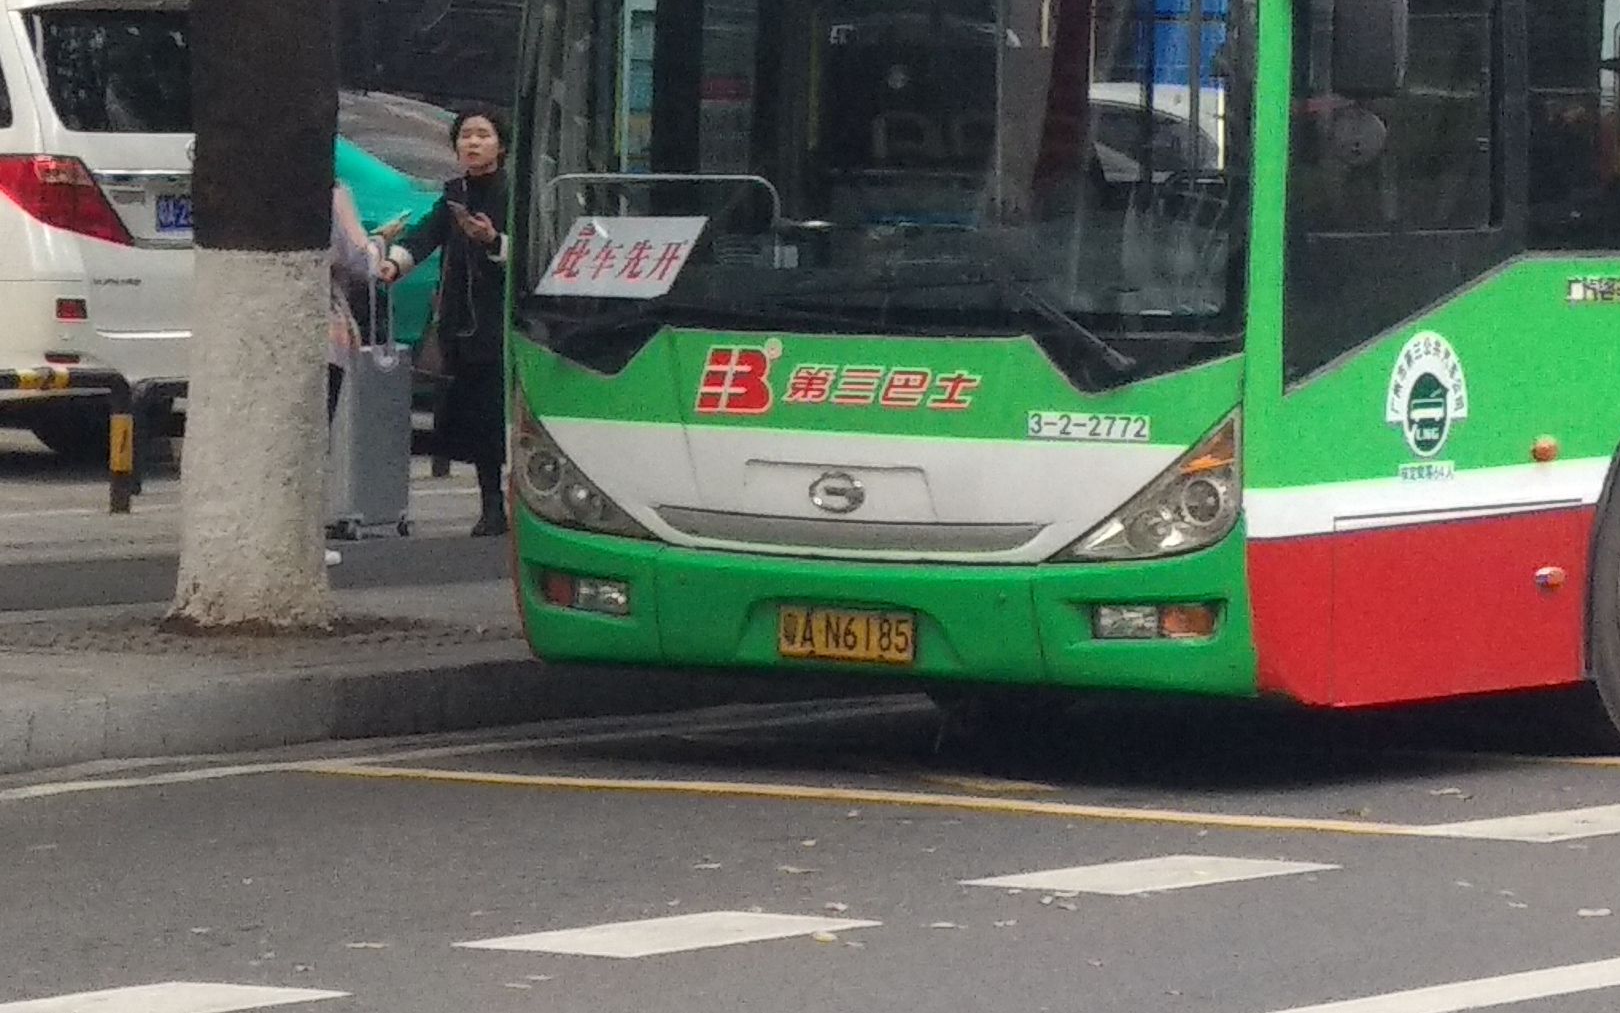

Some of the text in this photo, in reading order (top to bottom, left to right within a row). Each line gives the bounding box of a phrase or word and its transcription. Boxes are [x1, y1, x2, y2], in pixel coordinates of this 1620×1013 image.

[783, 363, 982, 411] 第三巴士
[1030, 412, 1147, 438] 3-2-2772
